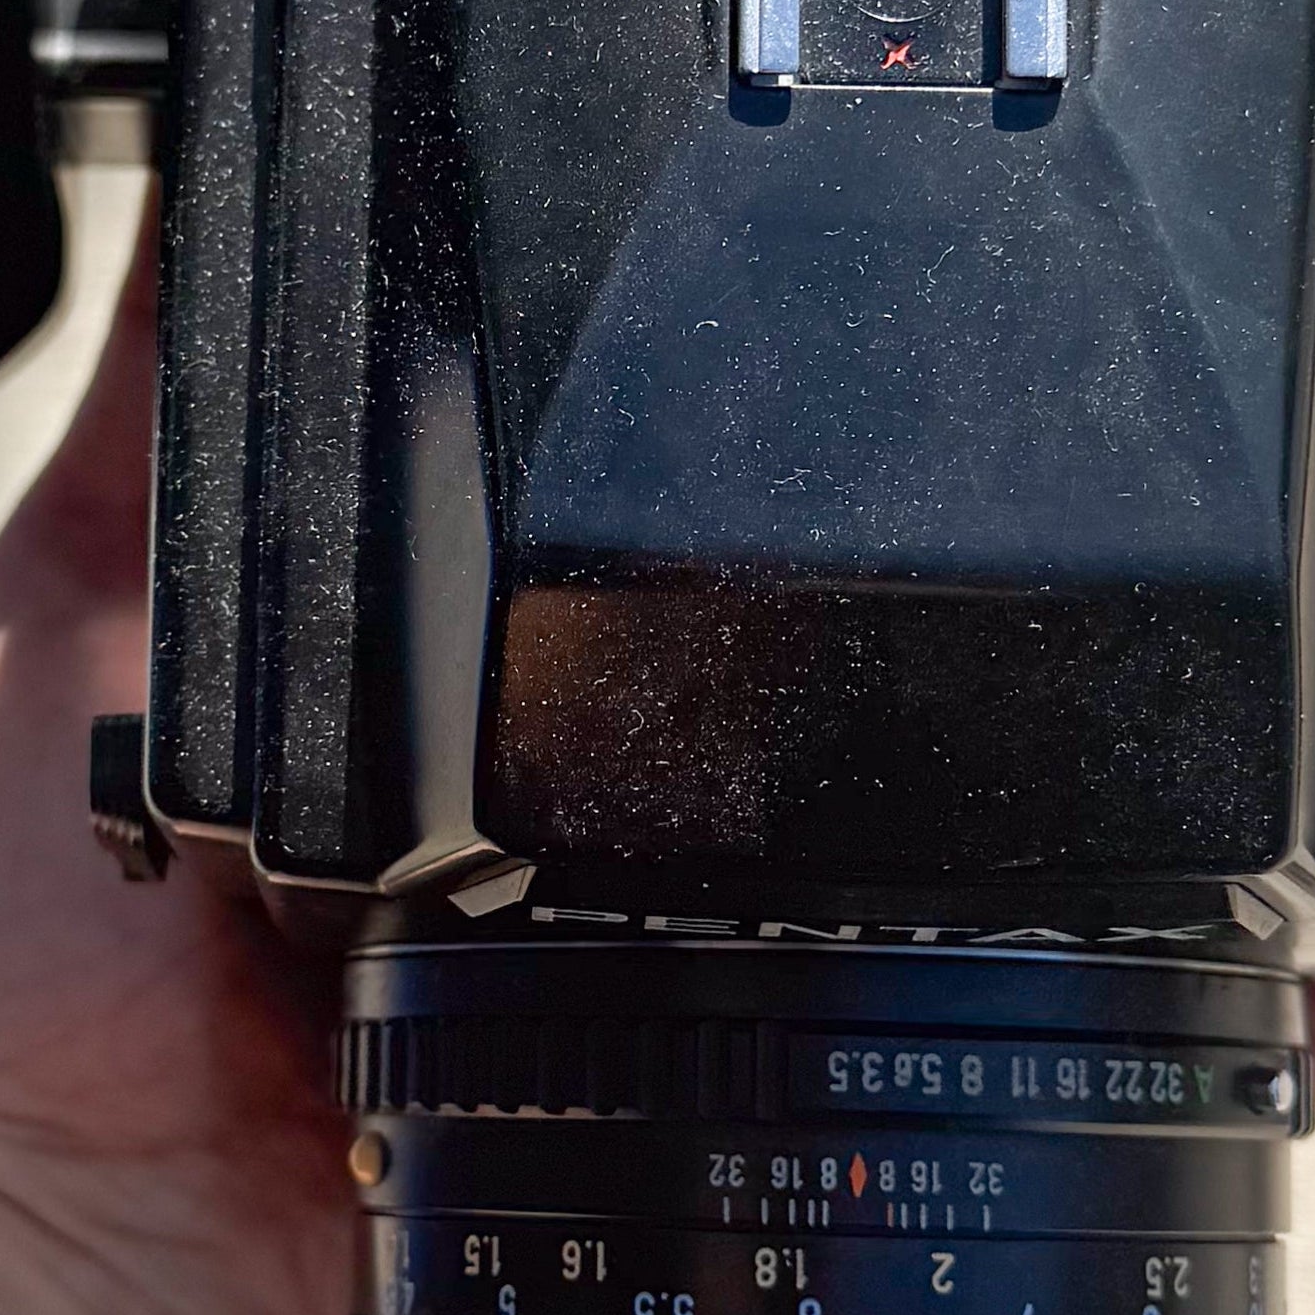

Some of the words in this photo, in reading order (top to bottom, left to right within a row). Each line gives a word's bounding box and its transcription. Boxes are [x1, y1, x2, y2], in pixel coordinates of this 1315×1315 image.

[532, 906, 1212, 942] PENTAX
[828, 1051, 883, 1093] 3.5
[961, 1055, 984, 1096] 8
[1012, 1057, 1038, 1099] 11
[1057, 1058, 1091, 1100] 16
[1105, 1061, 1143, 1102] 22
[1151, 1061, 1183, 1103] 32
[709, 1154, 744, 1187] 32
[771, 1157, 803, 1190] 16
[821, 1158, 837, 1190] 8
[880, 1160, 896, 1191] 8
[911, 1161, 942, 1194] 16
[969, 1162, 1003, 1195] 32
[465, 1235, 501, 1277] 1.5
[563, 1240, 606, 1282] 1.6
[931, 1252, 955, 1293] 2
[1146, 1256, 1189, 1299] 2.5
